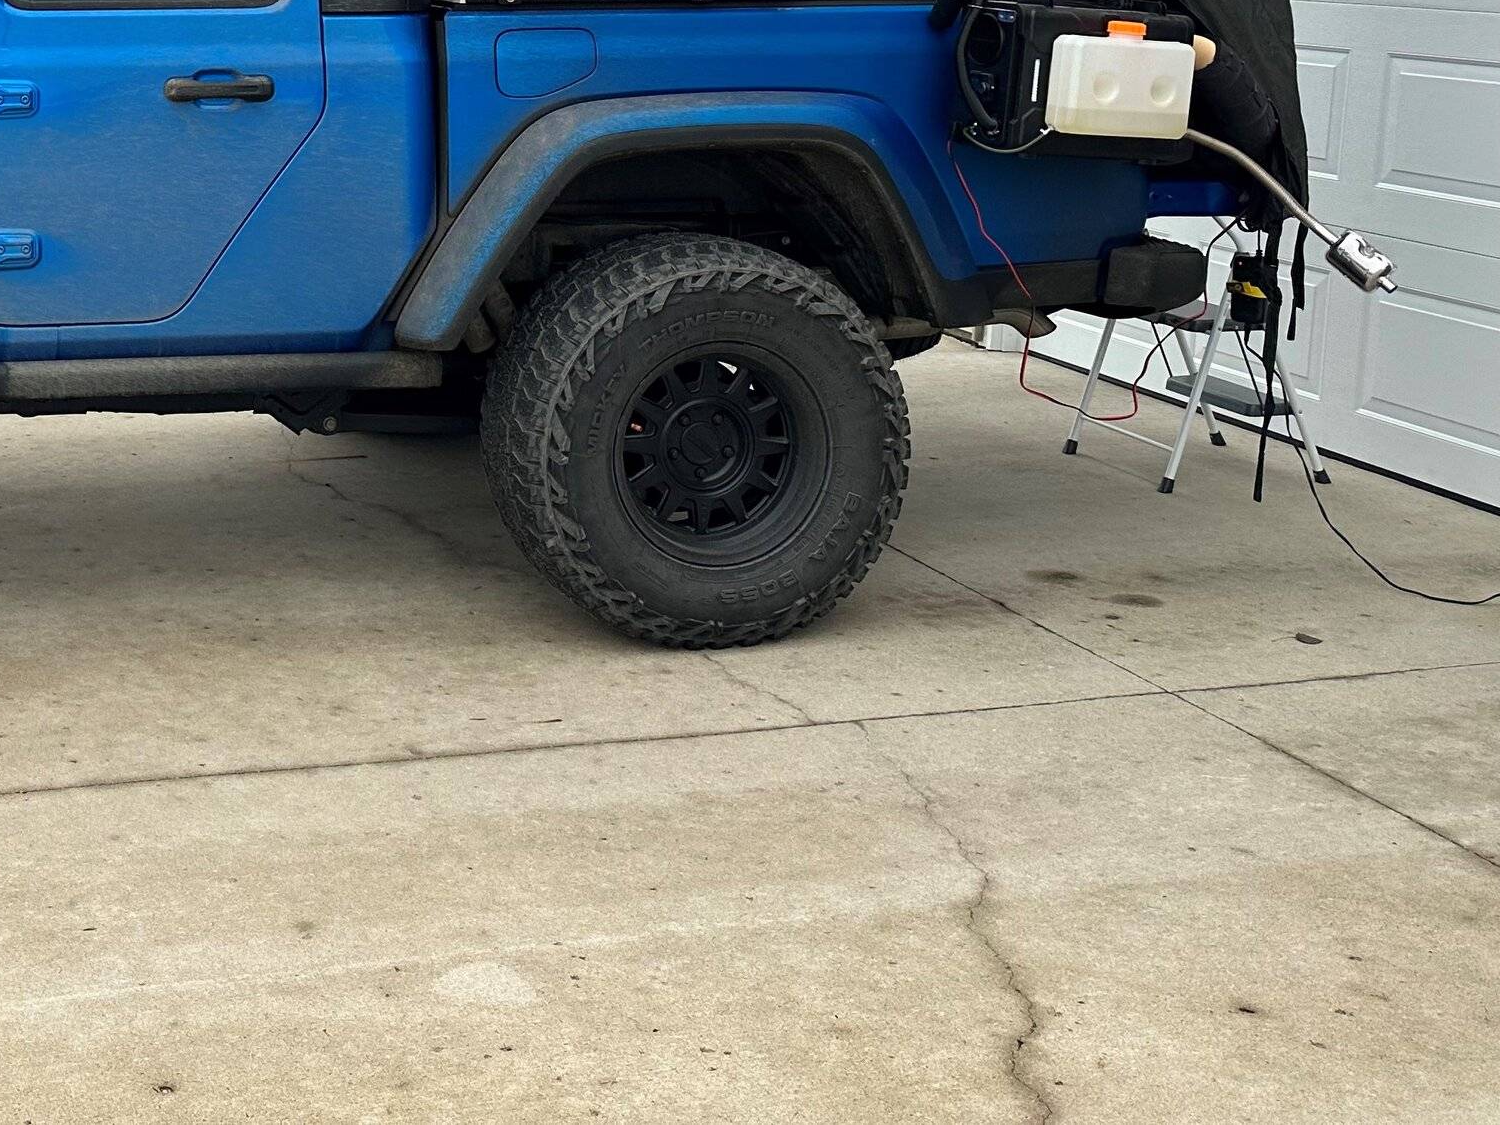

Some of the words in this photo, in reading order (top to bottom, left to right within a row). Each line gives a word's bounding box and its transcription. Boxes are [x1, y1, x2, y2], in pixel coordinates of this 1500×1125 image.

[638, 309, 776, 353] THOMPSON
[807, 491, 863, 562] BAJA
[717, 568, 800, 605] BOSS
